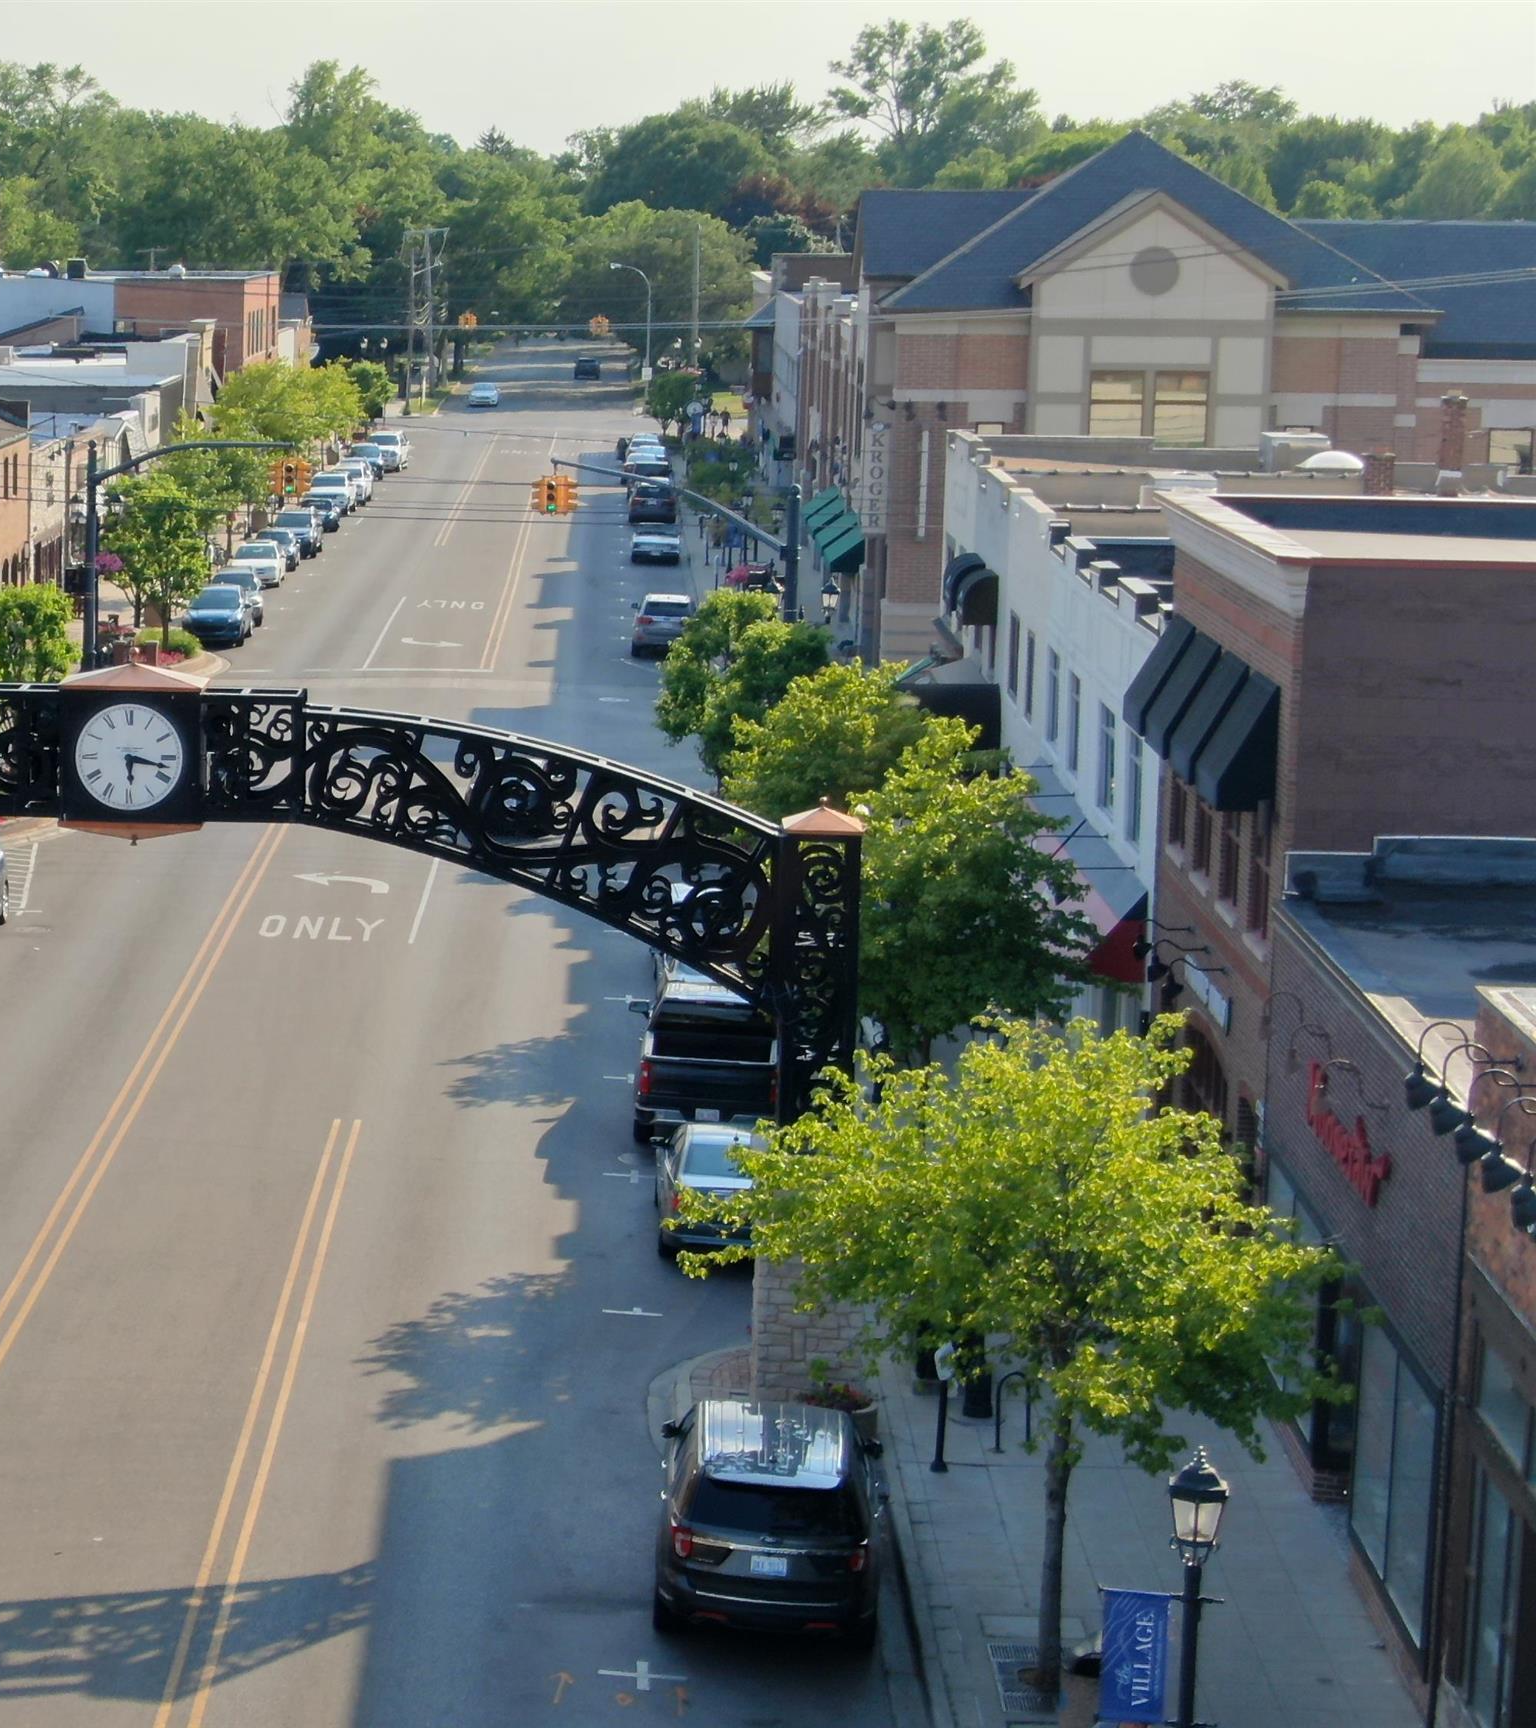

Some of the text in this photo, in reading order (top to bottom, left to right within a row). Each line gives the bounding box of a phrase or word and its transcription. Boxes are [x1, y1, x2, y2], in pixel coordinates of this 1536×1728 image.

[868, 433, 885, 527] KROGER
[416, 599, 485, 610] ONLY
[258, 914, 385, 942] ONLY
[1131, 1610, 1154, 1706] VILLAGE
